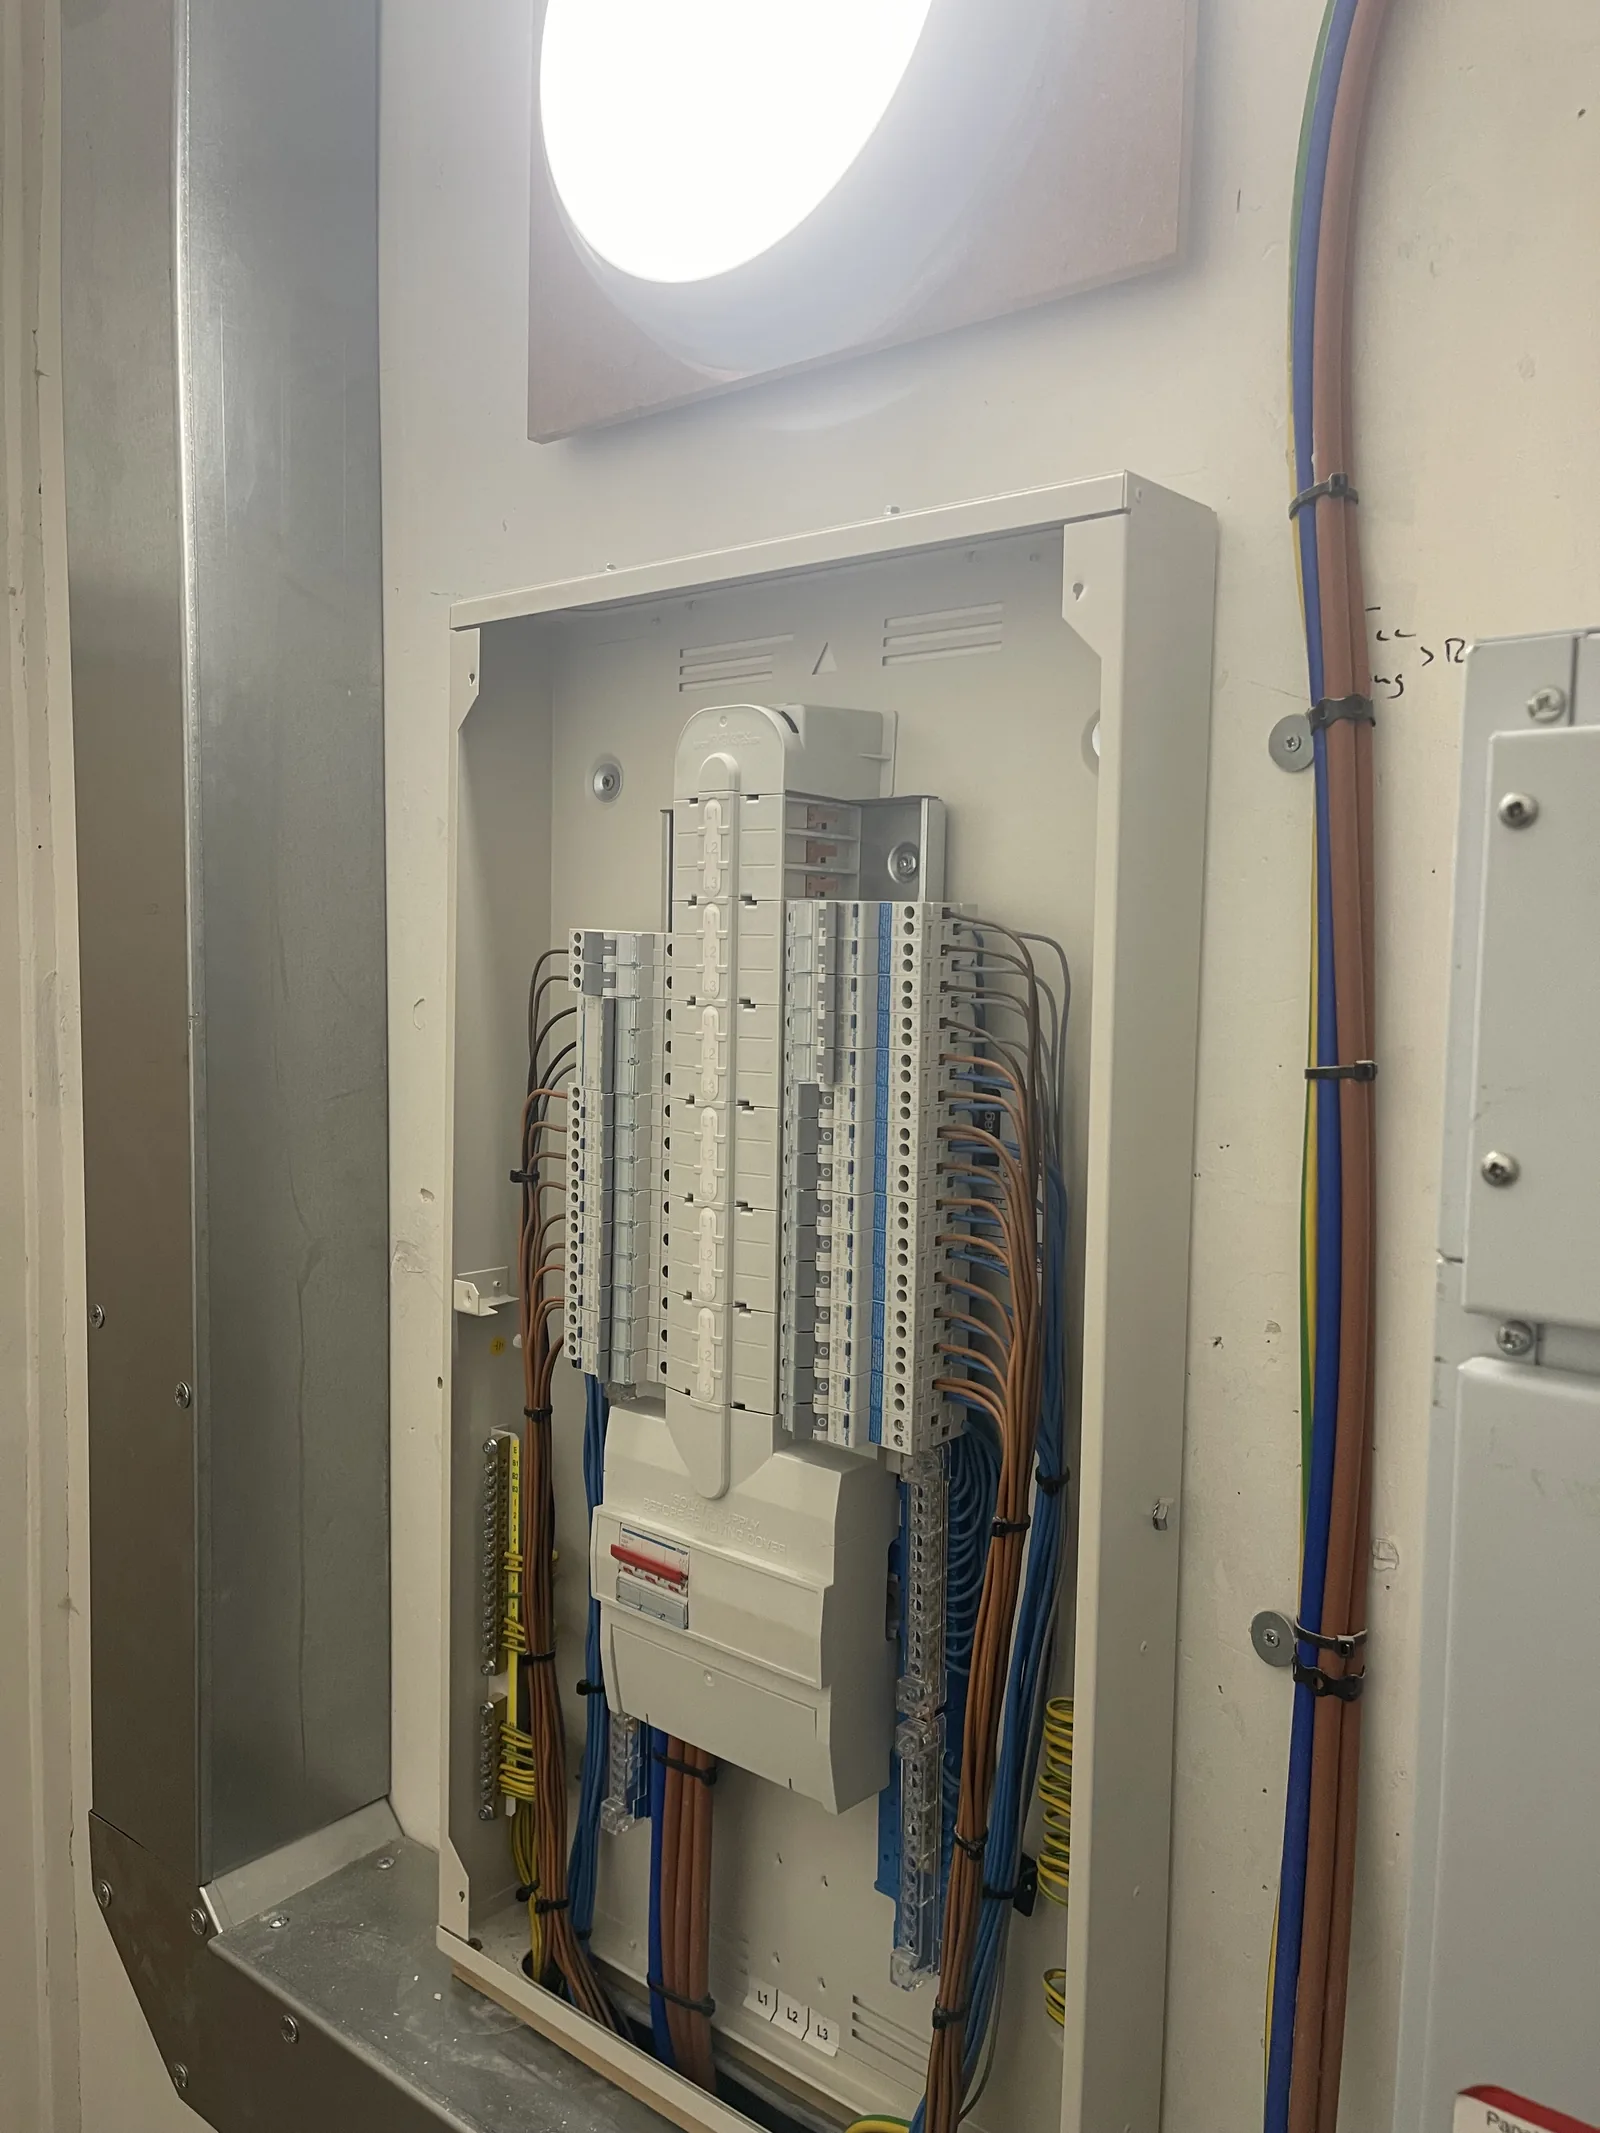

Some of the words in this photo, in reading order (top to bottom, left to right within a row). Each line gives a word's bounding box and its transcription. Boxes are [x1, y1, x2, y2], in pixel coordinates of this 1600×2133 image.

[705, 841, 718, 855] L2
[704, 876, 717, 890] L3
[703, 979, 717, 993] L3
[757, 1990, 768, 2006] L1
[787, 2006, 798, 2024] L2
[817, 2024, 828, 2041] L3
[1486, 2110, 1540, 2133] Pan
